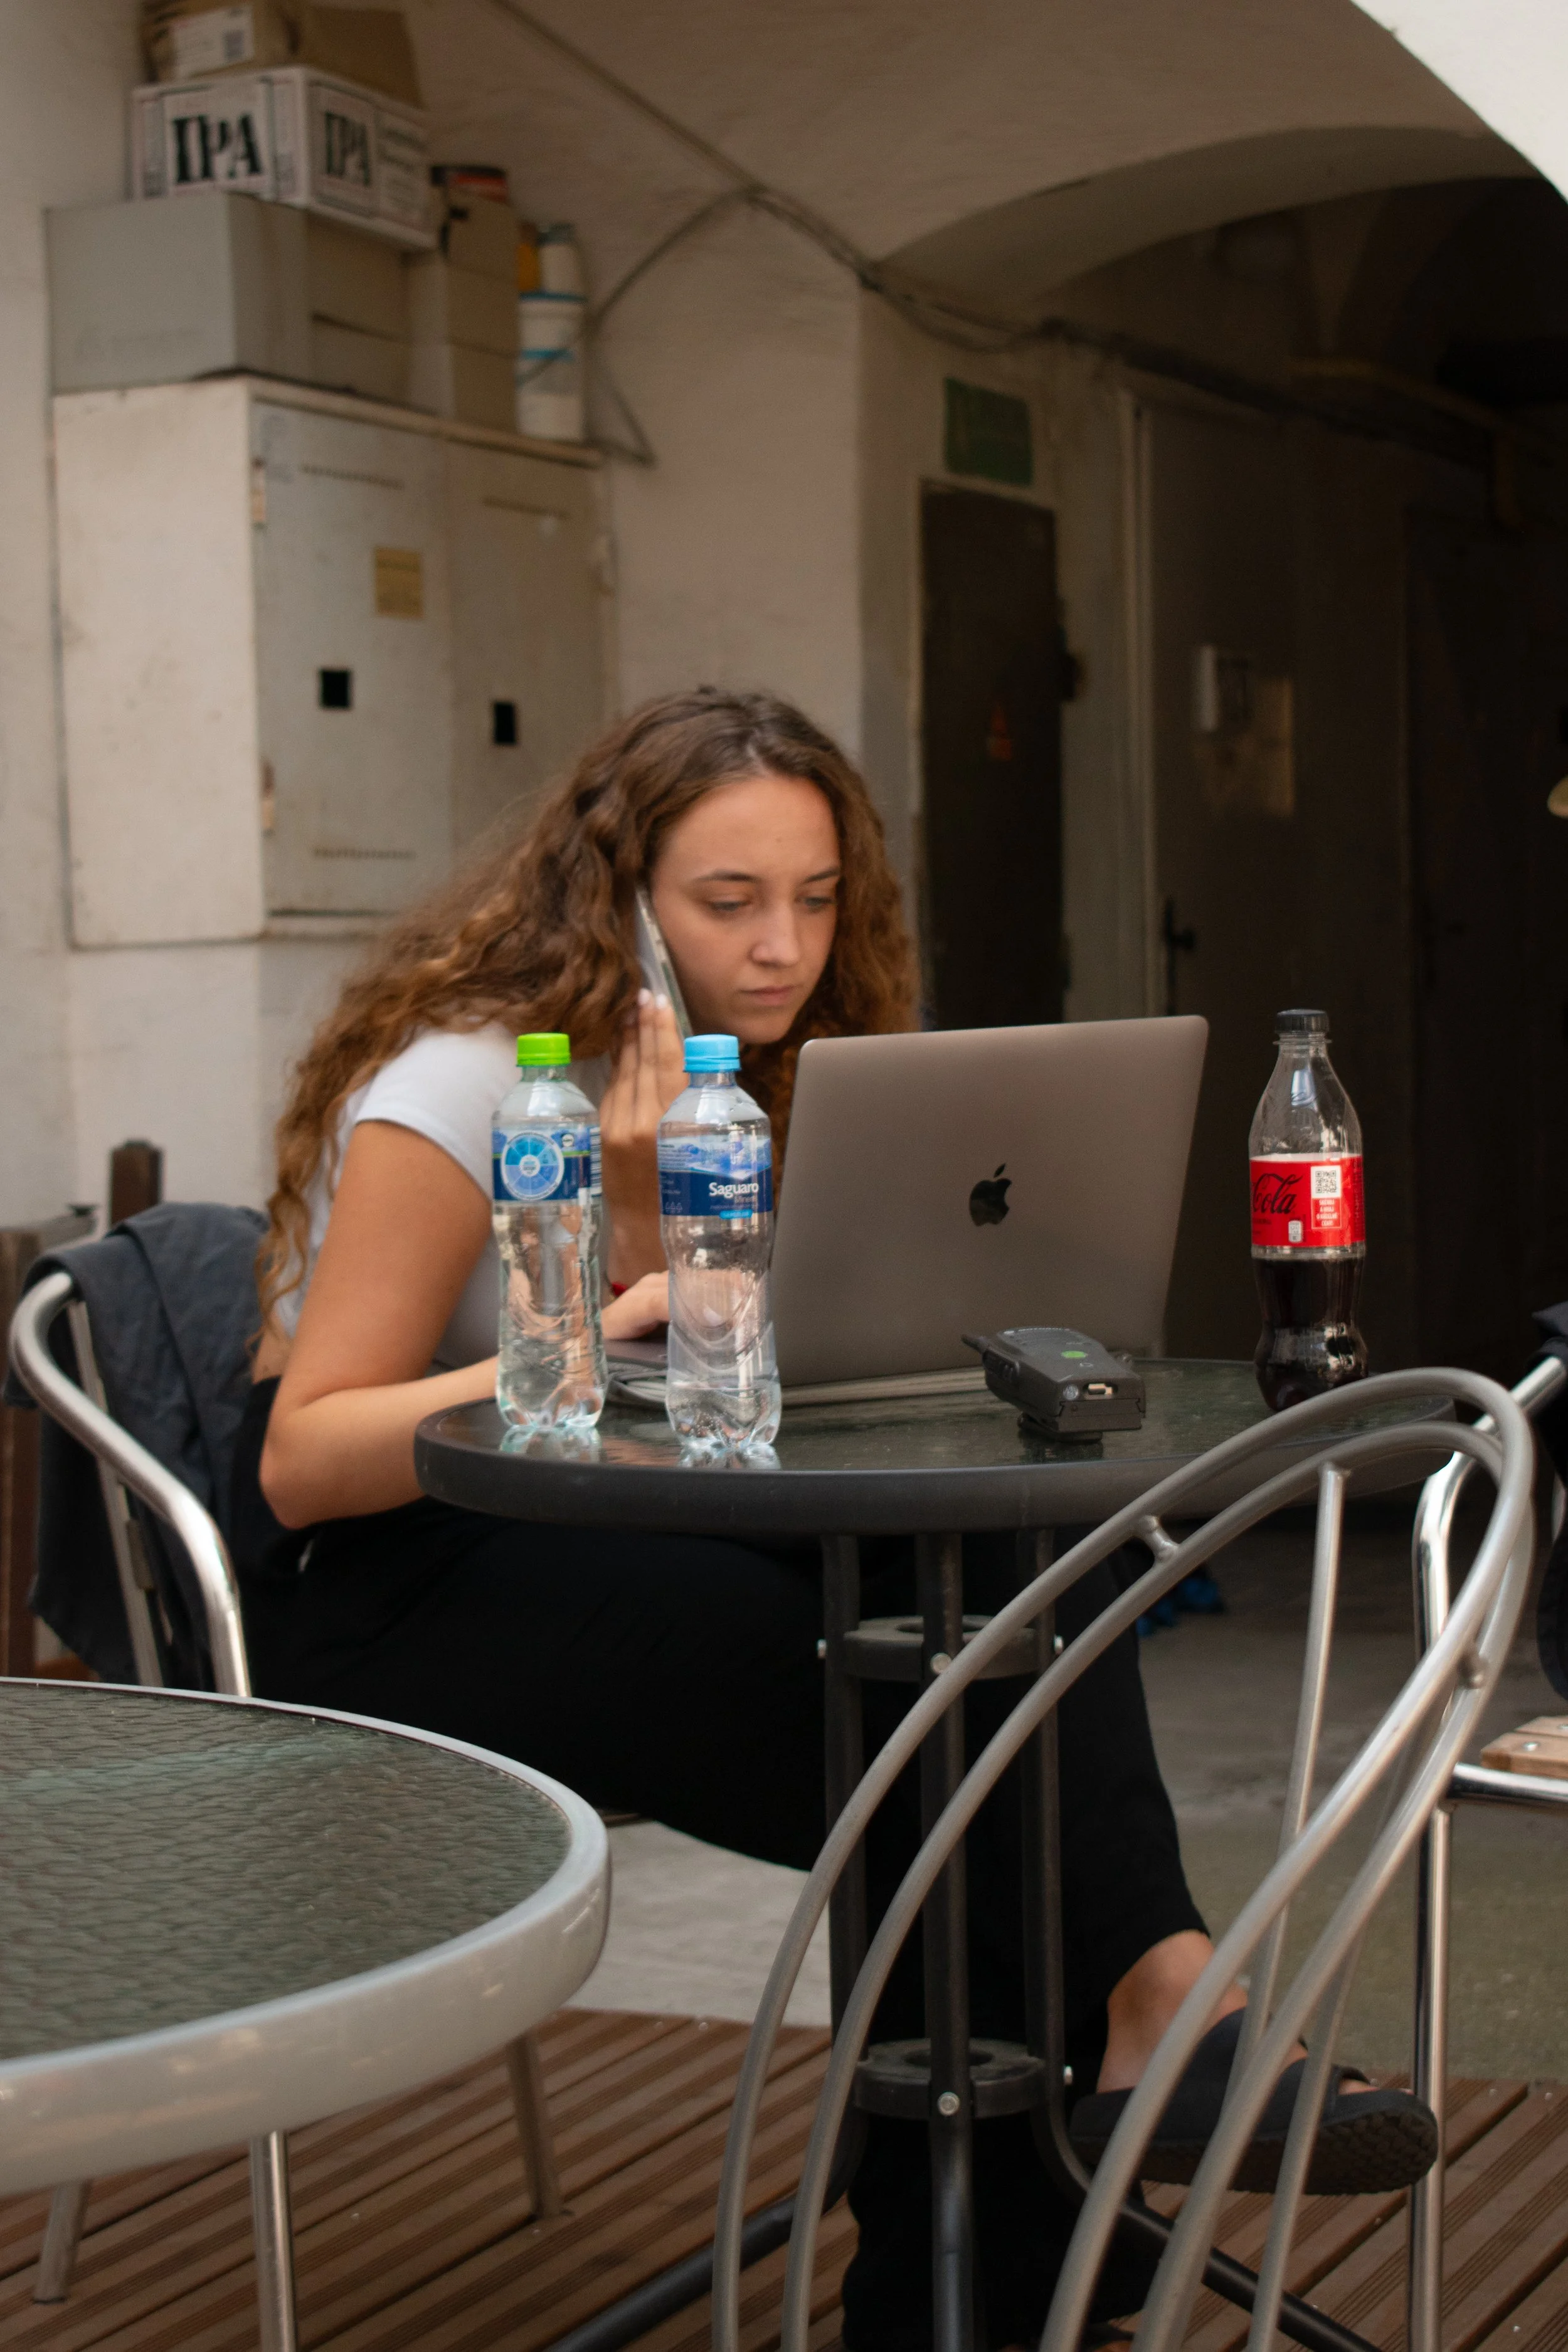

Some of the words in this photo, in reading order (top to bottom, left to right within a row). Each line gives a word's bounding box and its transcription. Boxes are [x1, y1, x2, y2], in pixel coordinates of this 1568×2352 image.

[172, 111, 262, 184] IPA
[324, 110, 372, 186] IPA
[709, 1182, 759, 1199] Saguaro
[1253, 1173, 1303, 1214] Cola
